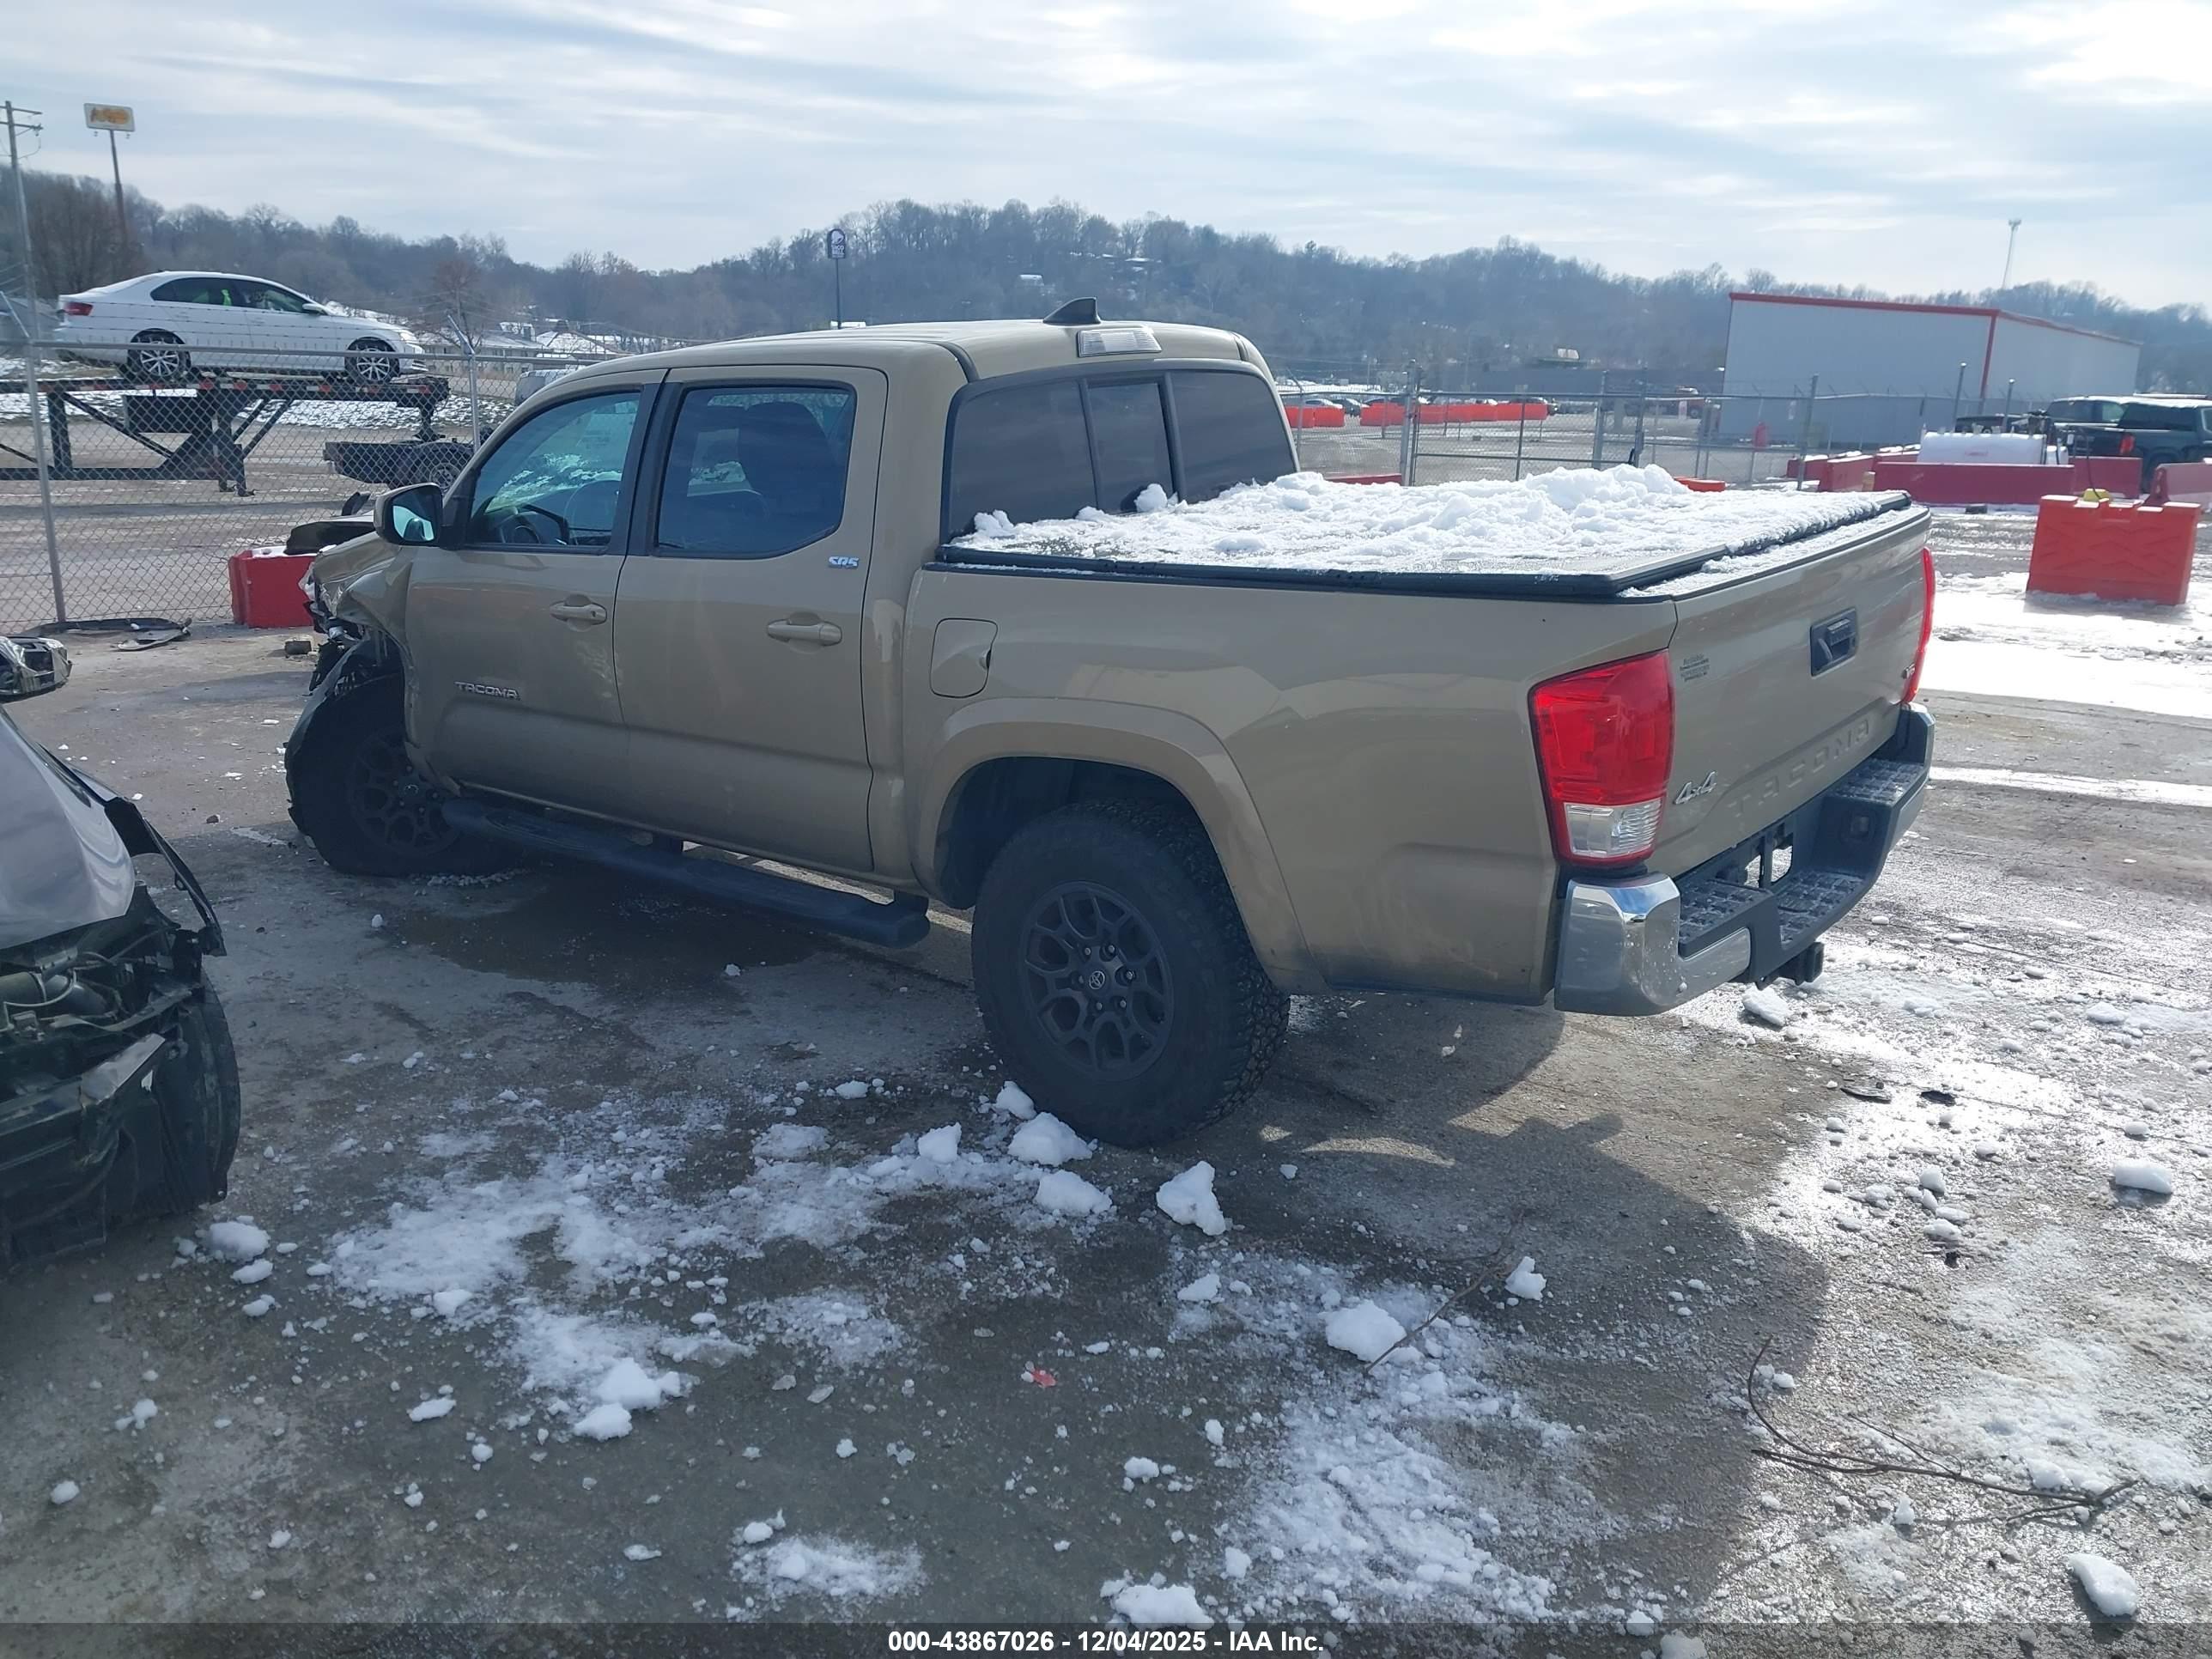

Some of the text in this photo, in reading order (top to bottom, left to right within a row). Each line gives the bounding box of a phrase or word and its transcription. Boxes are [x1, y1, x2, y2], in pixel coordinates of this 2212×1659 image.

[453, 681, 521, 701] TACOMA
[1727, 719, 1869, 818] TACOMA
[1674, 770, 1717, 805] 4x4
